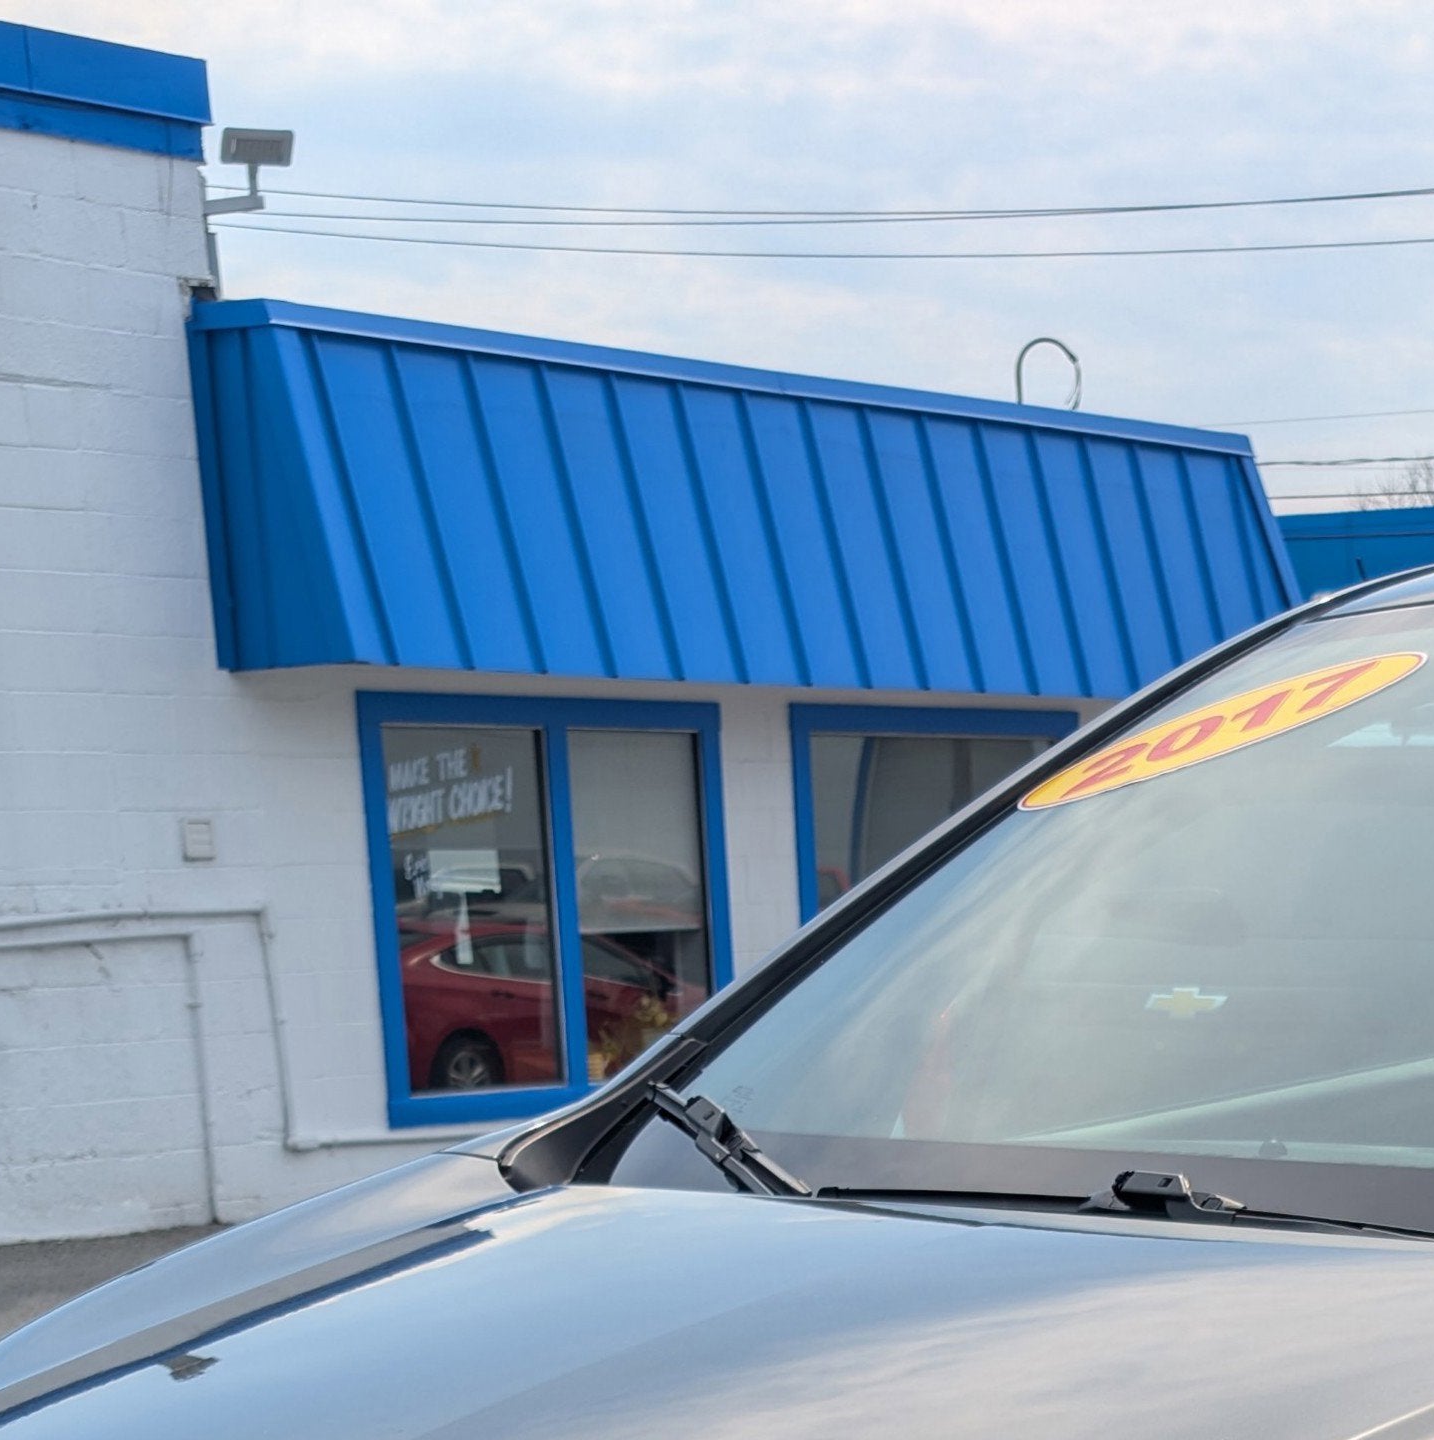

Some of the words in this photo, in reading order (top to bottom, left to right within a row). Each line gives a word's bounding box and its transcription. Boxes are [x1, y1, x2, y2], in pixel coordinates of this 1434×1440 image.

[389, 757, 430, 792] MAKE
[435, 748, 467, 782] THE
[1058, 660, 1381, 799] 2017
